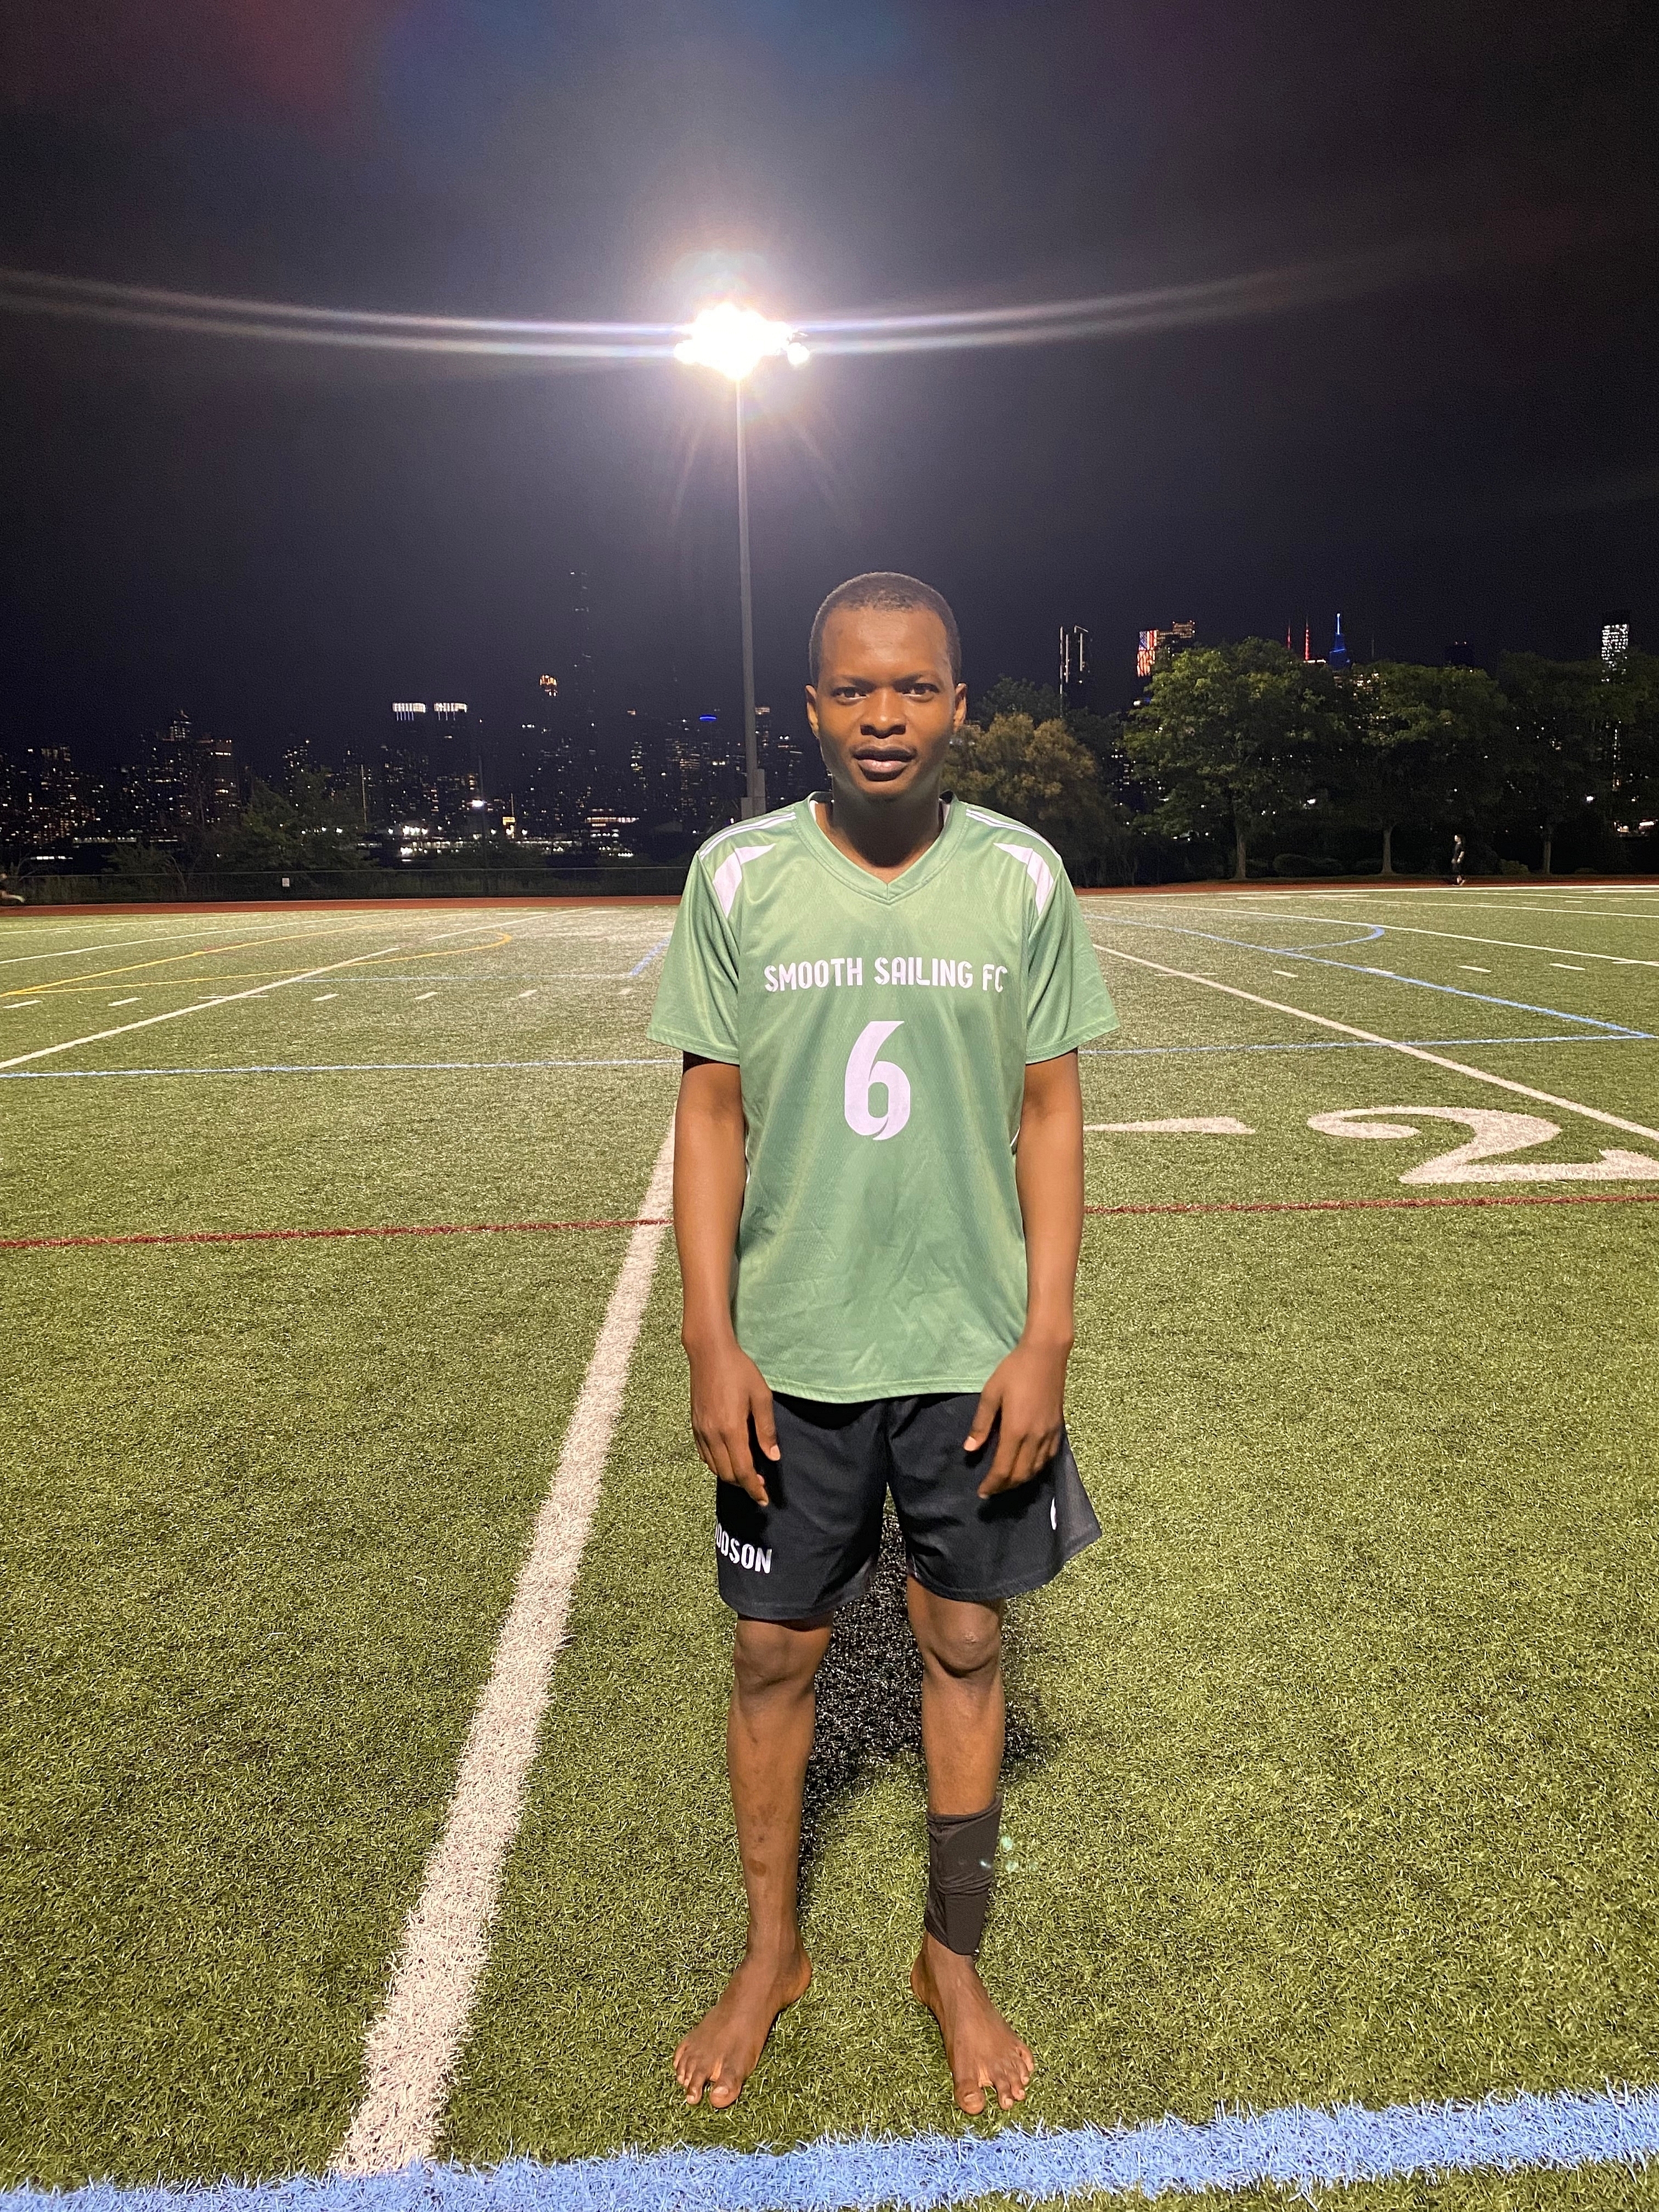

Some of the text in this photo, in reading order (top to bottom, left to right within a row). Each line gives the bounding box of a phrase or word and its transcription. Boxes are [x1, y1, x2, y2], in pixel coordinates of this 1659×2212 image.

[764, 956, 1008, 992] SMOOTH SAILING FC
[844, 1020, 911, 1141] 6
